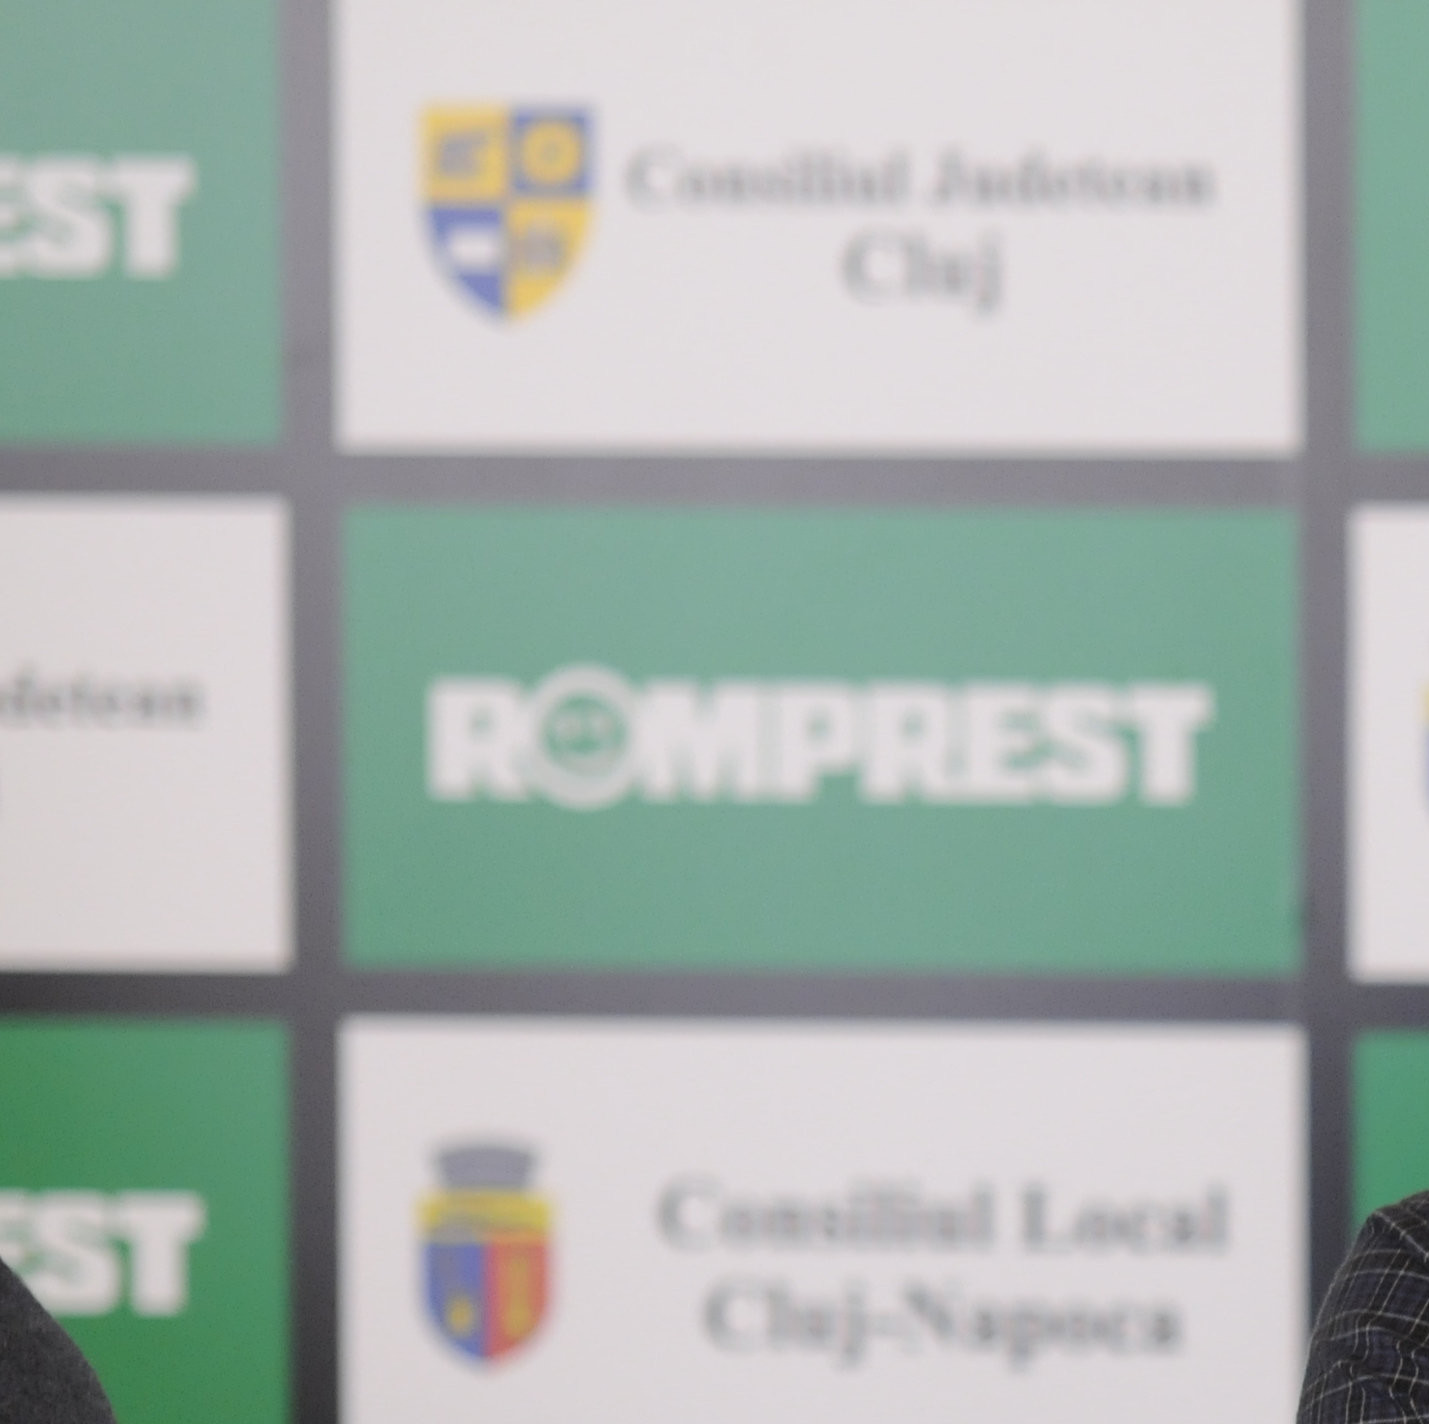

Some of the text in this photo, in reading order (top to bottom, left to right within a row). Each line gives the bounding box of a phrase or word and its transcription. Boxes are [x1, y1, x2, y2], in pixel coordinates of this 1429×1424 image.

[625, 144, 1217, 212] Consiliul Judetean
[840, 226, 1004, 318] Cluj
[427, 663, 1214, 812] ROMPREST
[657, 1173, 1232, 1256] Consiliul Local
[702, 1277, 1184, 1372] Cluj-Napoca
